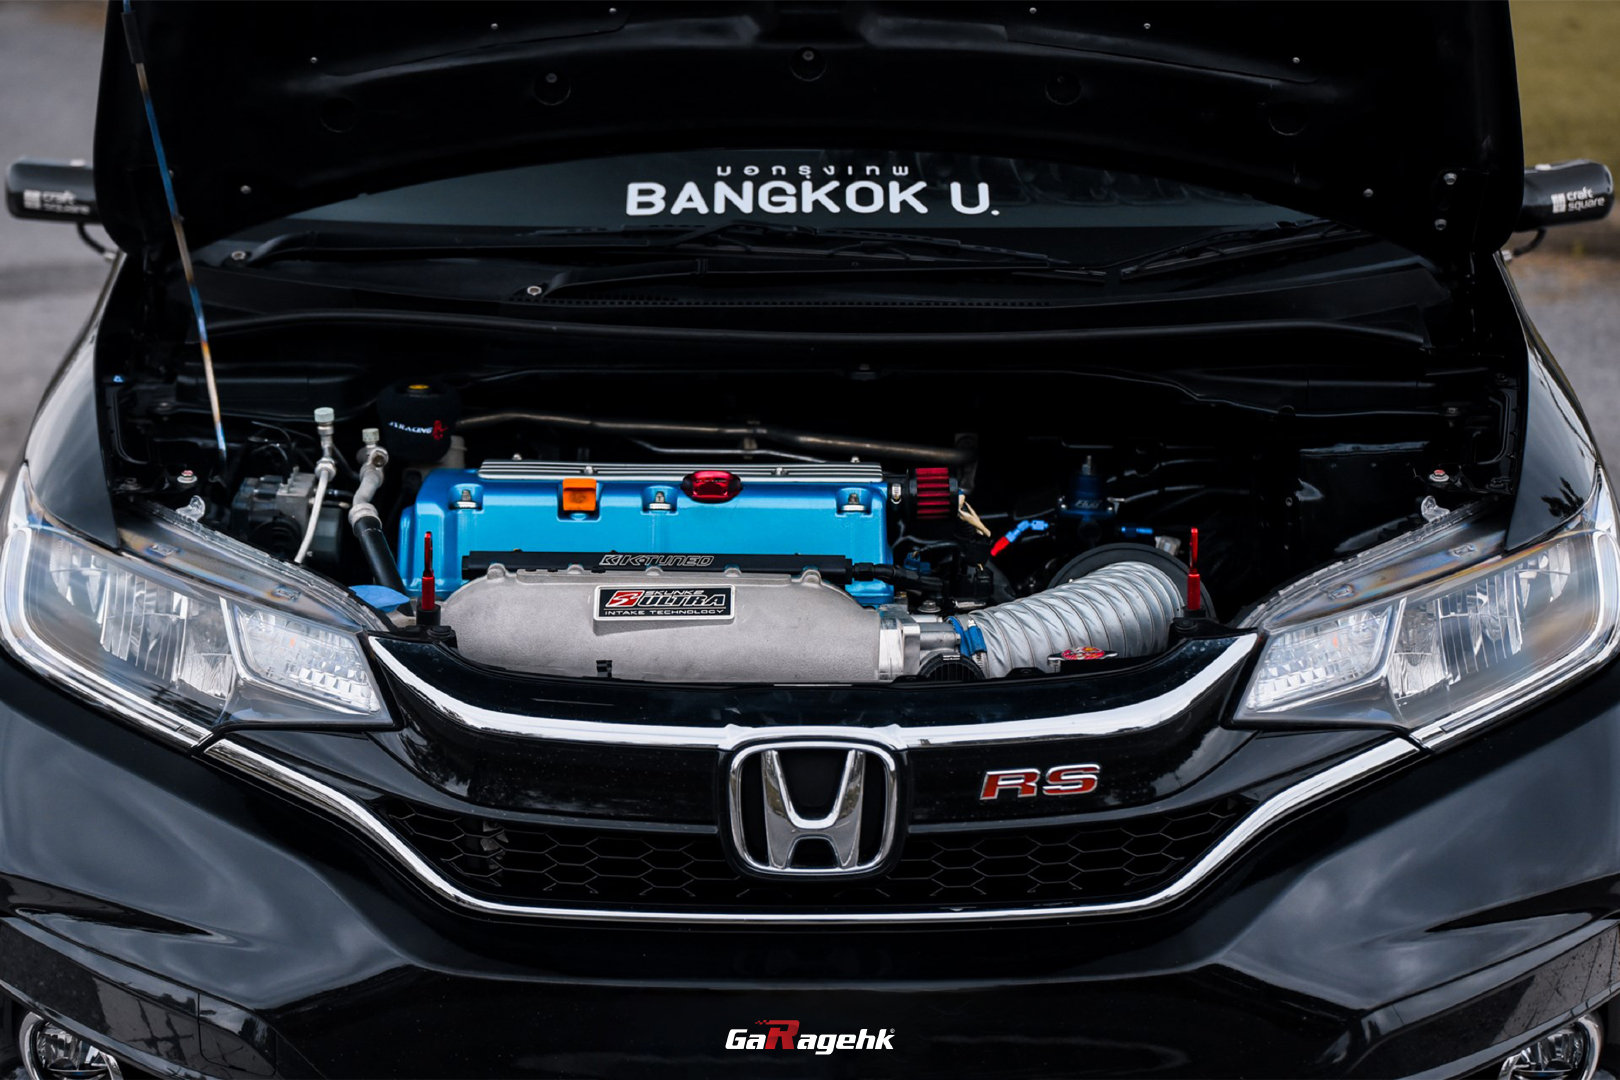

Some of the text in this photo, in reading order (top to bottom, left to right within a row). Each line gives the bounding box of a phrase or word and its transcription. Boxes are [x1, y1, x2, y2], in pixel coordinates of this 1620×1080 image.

[626, 180, 1000, 216] BANGKOK U.
[1567, 196, 1605, 212] square
[637, 594, 726, 607] ULTRA
[980, 763, 1100, 800] RS
